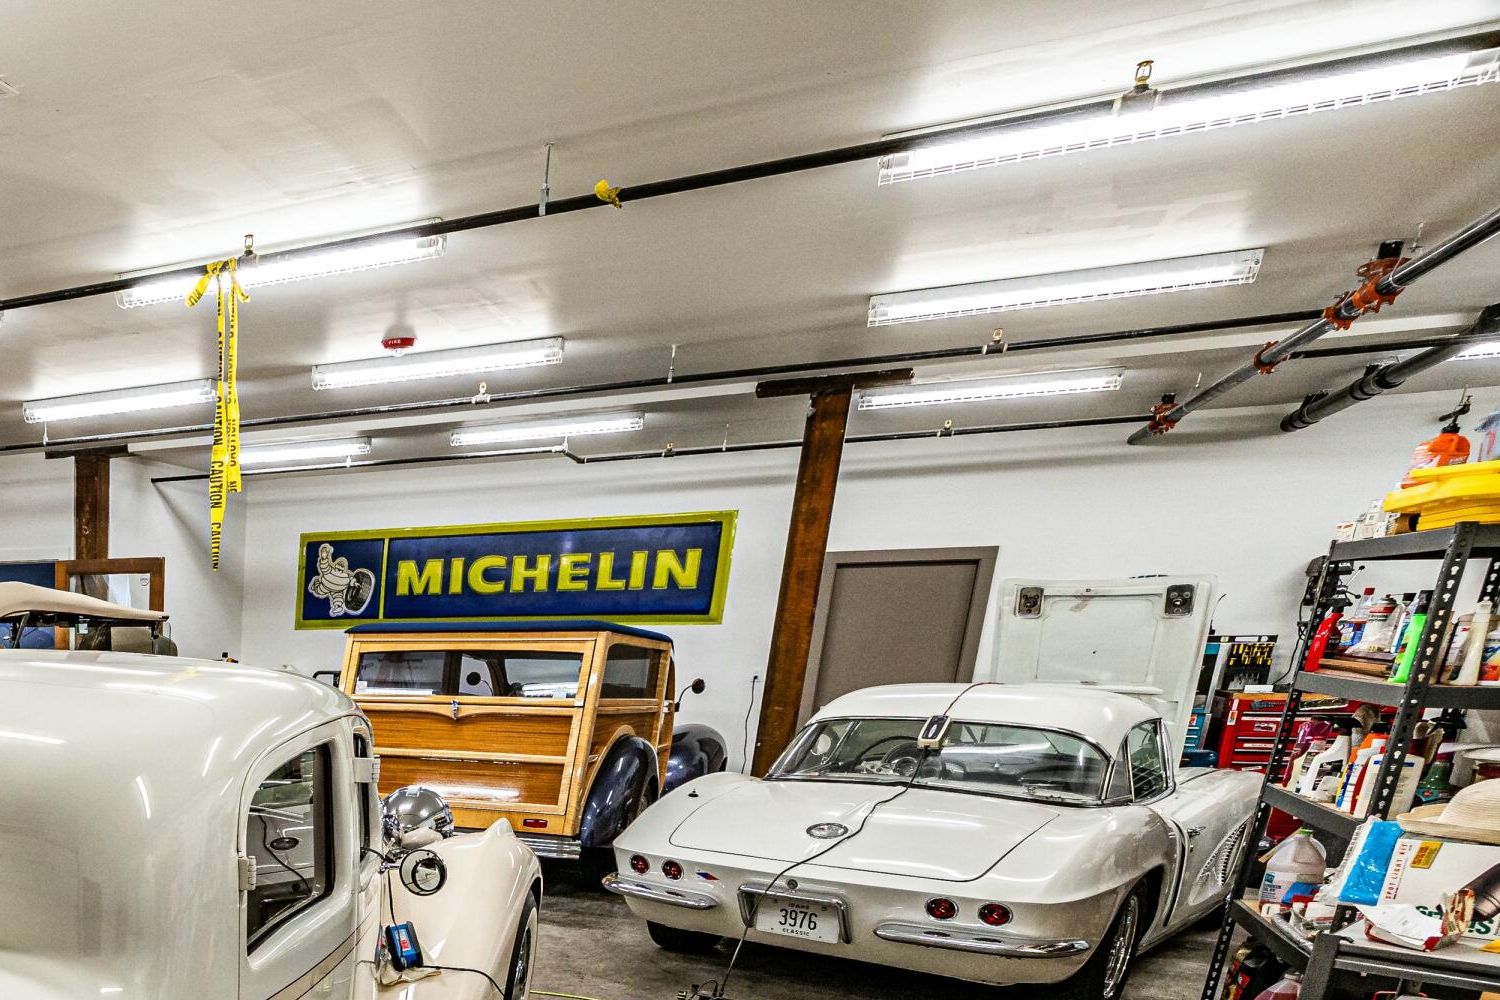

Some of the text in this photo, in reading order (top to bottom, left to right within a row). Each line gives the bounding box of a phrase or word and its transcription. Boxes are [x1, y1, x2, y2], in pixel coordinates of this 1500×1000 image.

[209, 461, 224, 509] CAUTION
[396, 548, 702, 596] MICHELIN
[779, 908, 818, 930] 3976
[782, 928, 810, 936] CLASSIC
